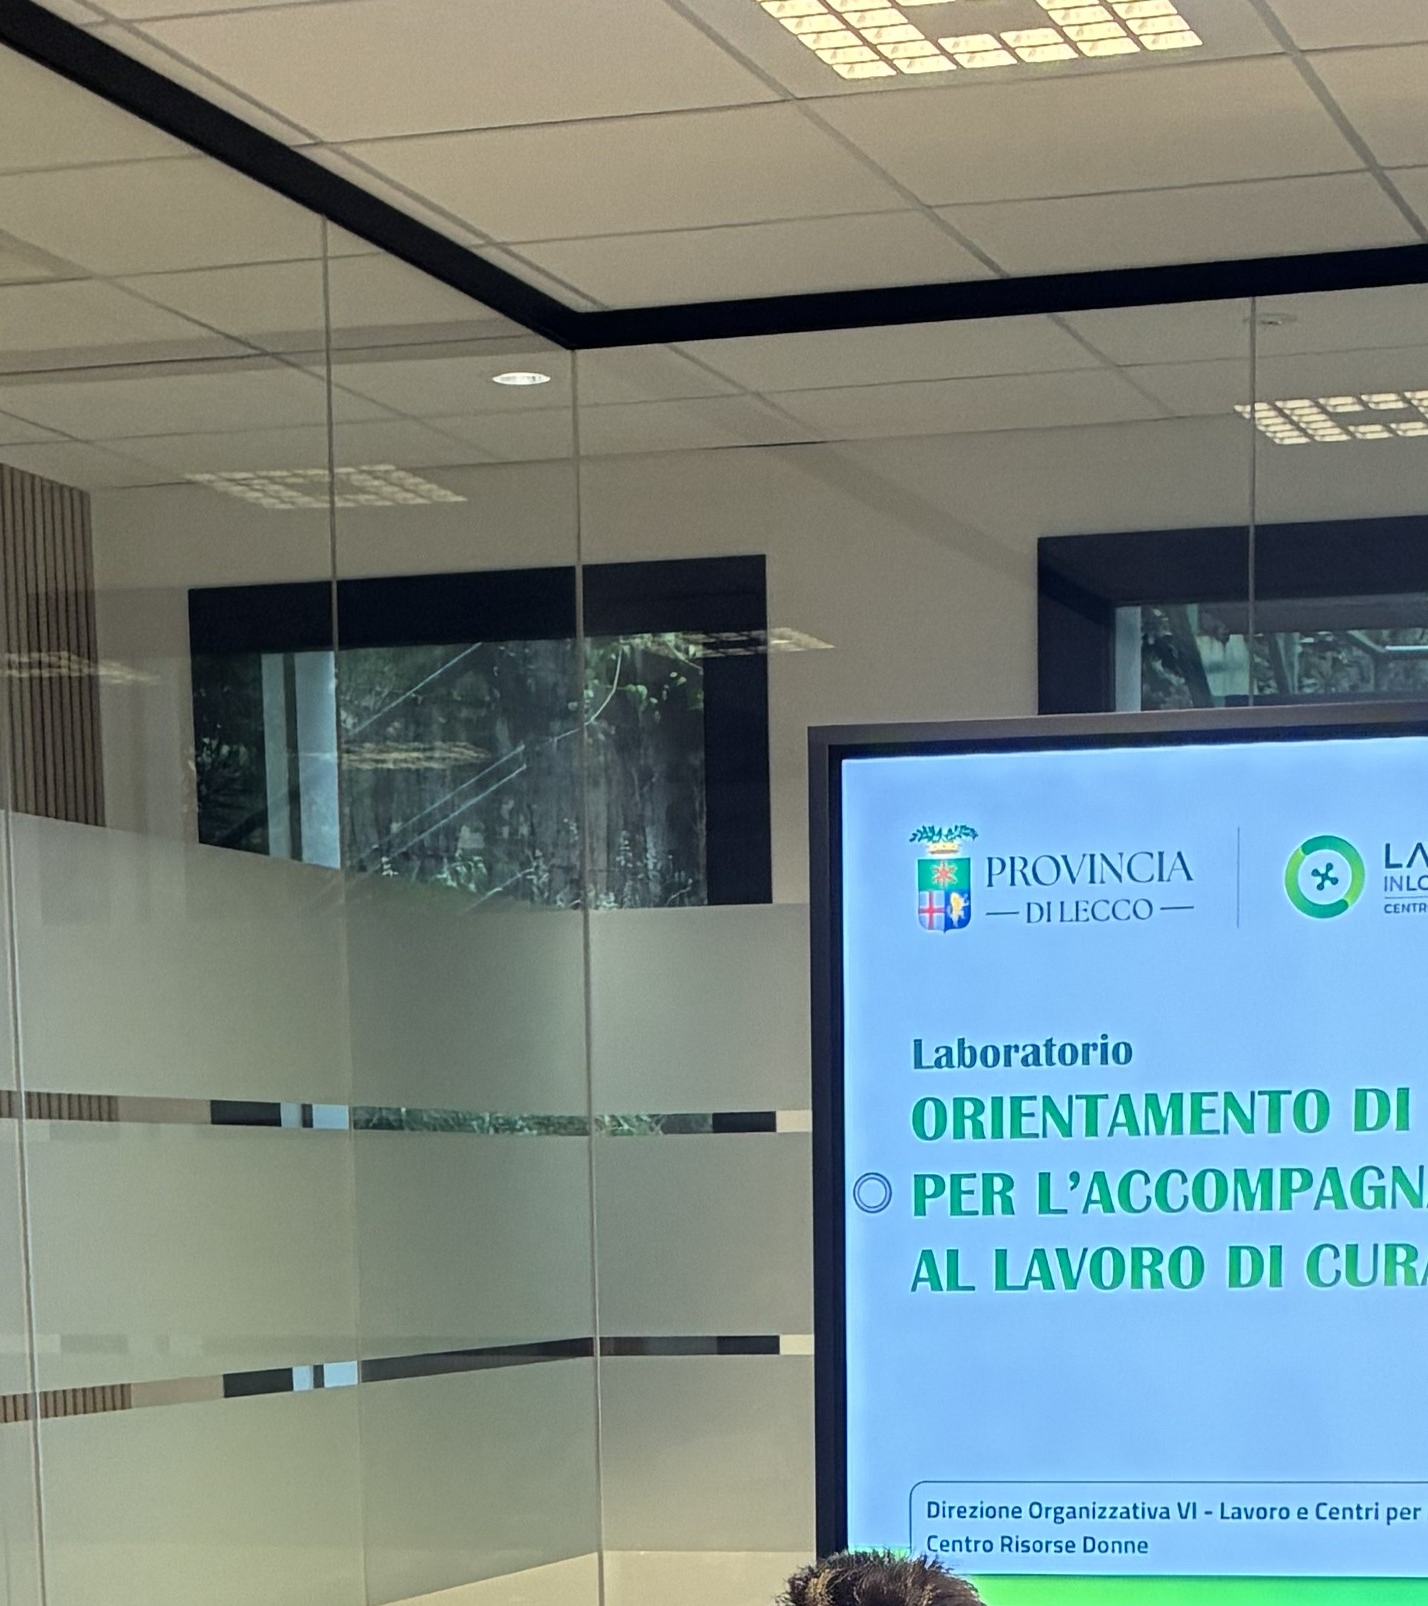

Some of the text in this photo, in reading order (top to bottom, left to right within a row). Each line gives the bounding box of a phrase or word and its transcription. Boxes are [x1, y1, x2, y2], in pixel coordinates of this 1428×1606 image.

[985, 849, 1194, 888] PROVINCIA
[1025, 898, 1154, 925] DI LECCO
[913, 1034, 1134, 1072] Laboratorio
[910, 1088, 1331, 1143] ORIENTAMENTO
[1353, 1088, 1410, 1134] DI
[913, 1170, 1015, 1218] PER
[910, 1248, 976, 1294] AL
[993, 1245, 1205, 1292] LAVORO
[1227, 1245, 1284, 1291] DI
[927, 1501, 1022, 1520] Direzione
[1029, 1501, 1170, 1524] Organizzativa
[1177, 1502, 1196, 1520] VI
[1220, 1502, 1290, 1520] Lavoro
[1297, 1506, 1308, 1520] e
[1315, 1501, 1379, 1520] Centri
[1386, 1505, 1421, 1525] per
[927, 1535, 1148, 1554] Centro Risorse Donne
